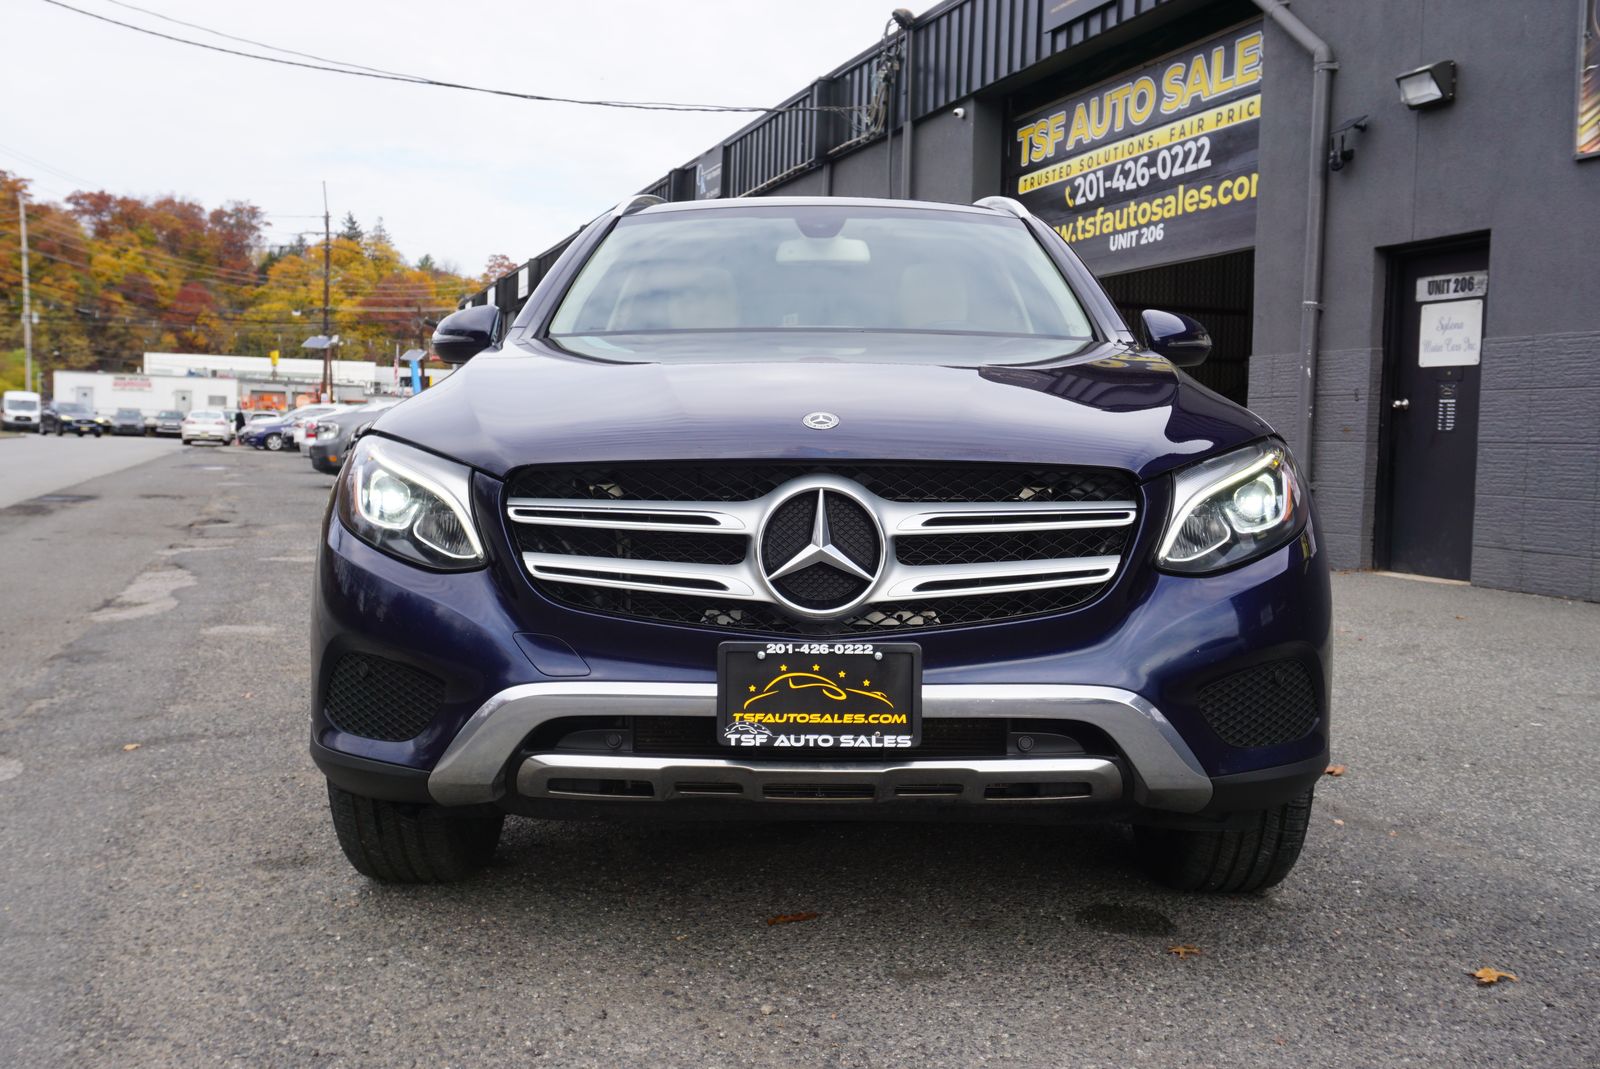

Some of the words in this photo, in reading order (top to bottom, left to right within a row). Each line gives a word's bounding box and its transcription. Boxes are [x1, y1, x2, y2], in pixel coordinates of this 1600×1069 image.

[1017, 110, 1066, 167] TSF
[1066, 76, 1156, 150] AUTO
[1160, 31, 1263, 114] SALE
[1023, 164, 1072, 191] TRUSTED
[1079, 135, 1160, 172] SOLUTIONS,
[1169, 117, 1205, 142] FAIR
[1215, 101, 1256, 128] PRIC
[1074, 137, 1212, 205] 201-426-0222
[1109, 229, 1139, 251] UNIT
[1140, 223, 1164, 245] 206
[1427, 279, 1451, 296] UNIT
[1453, 276, 1474, 293] 206
[766, 643, 874, 655] 201-426-0222
[732, 712, 907, 724] TSFAUTOSALES.COM
[726, 734, 768, 747] TSF
[774, 734, 834, 747] AUTO
[839, 734, 912, 748] SALES
